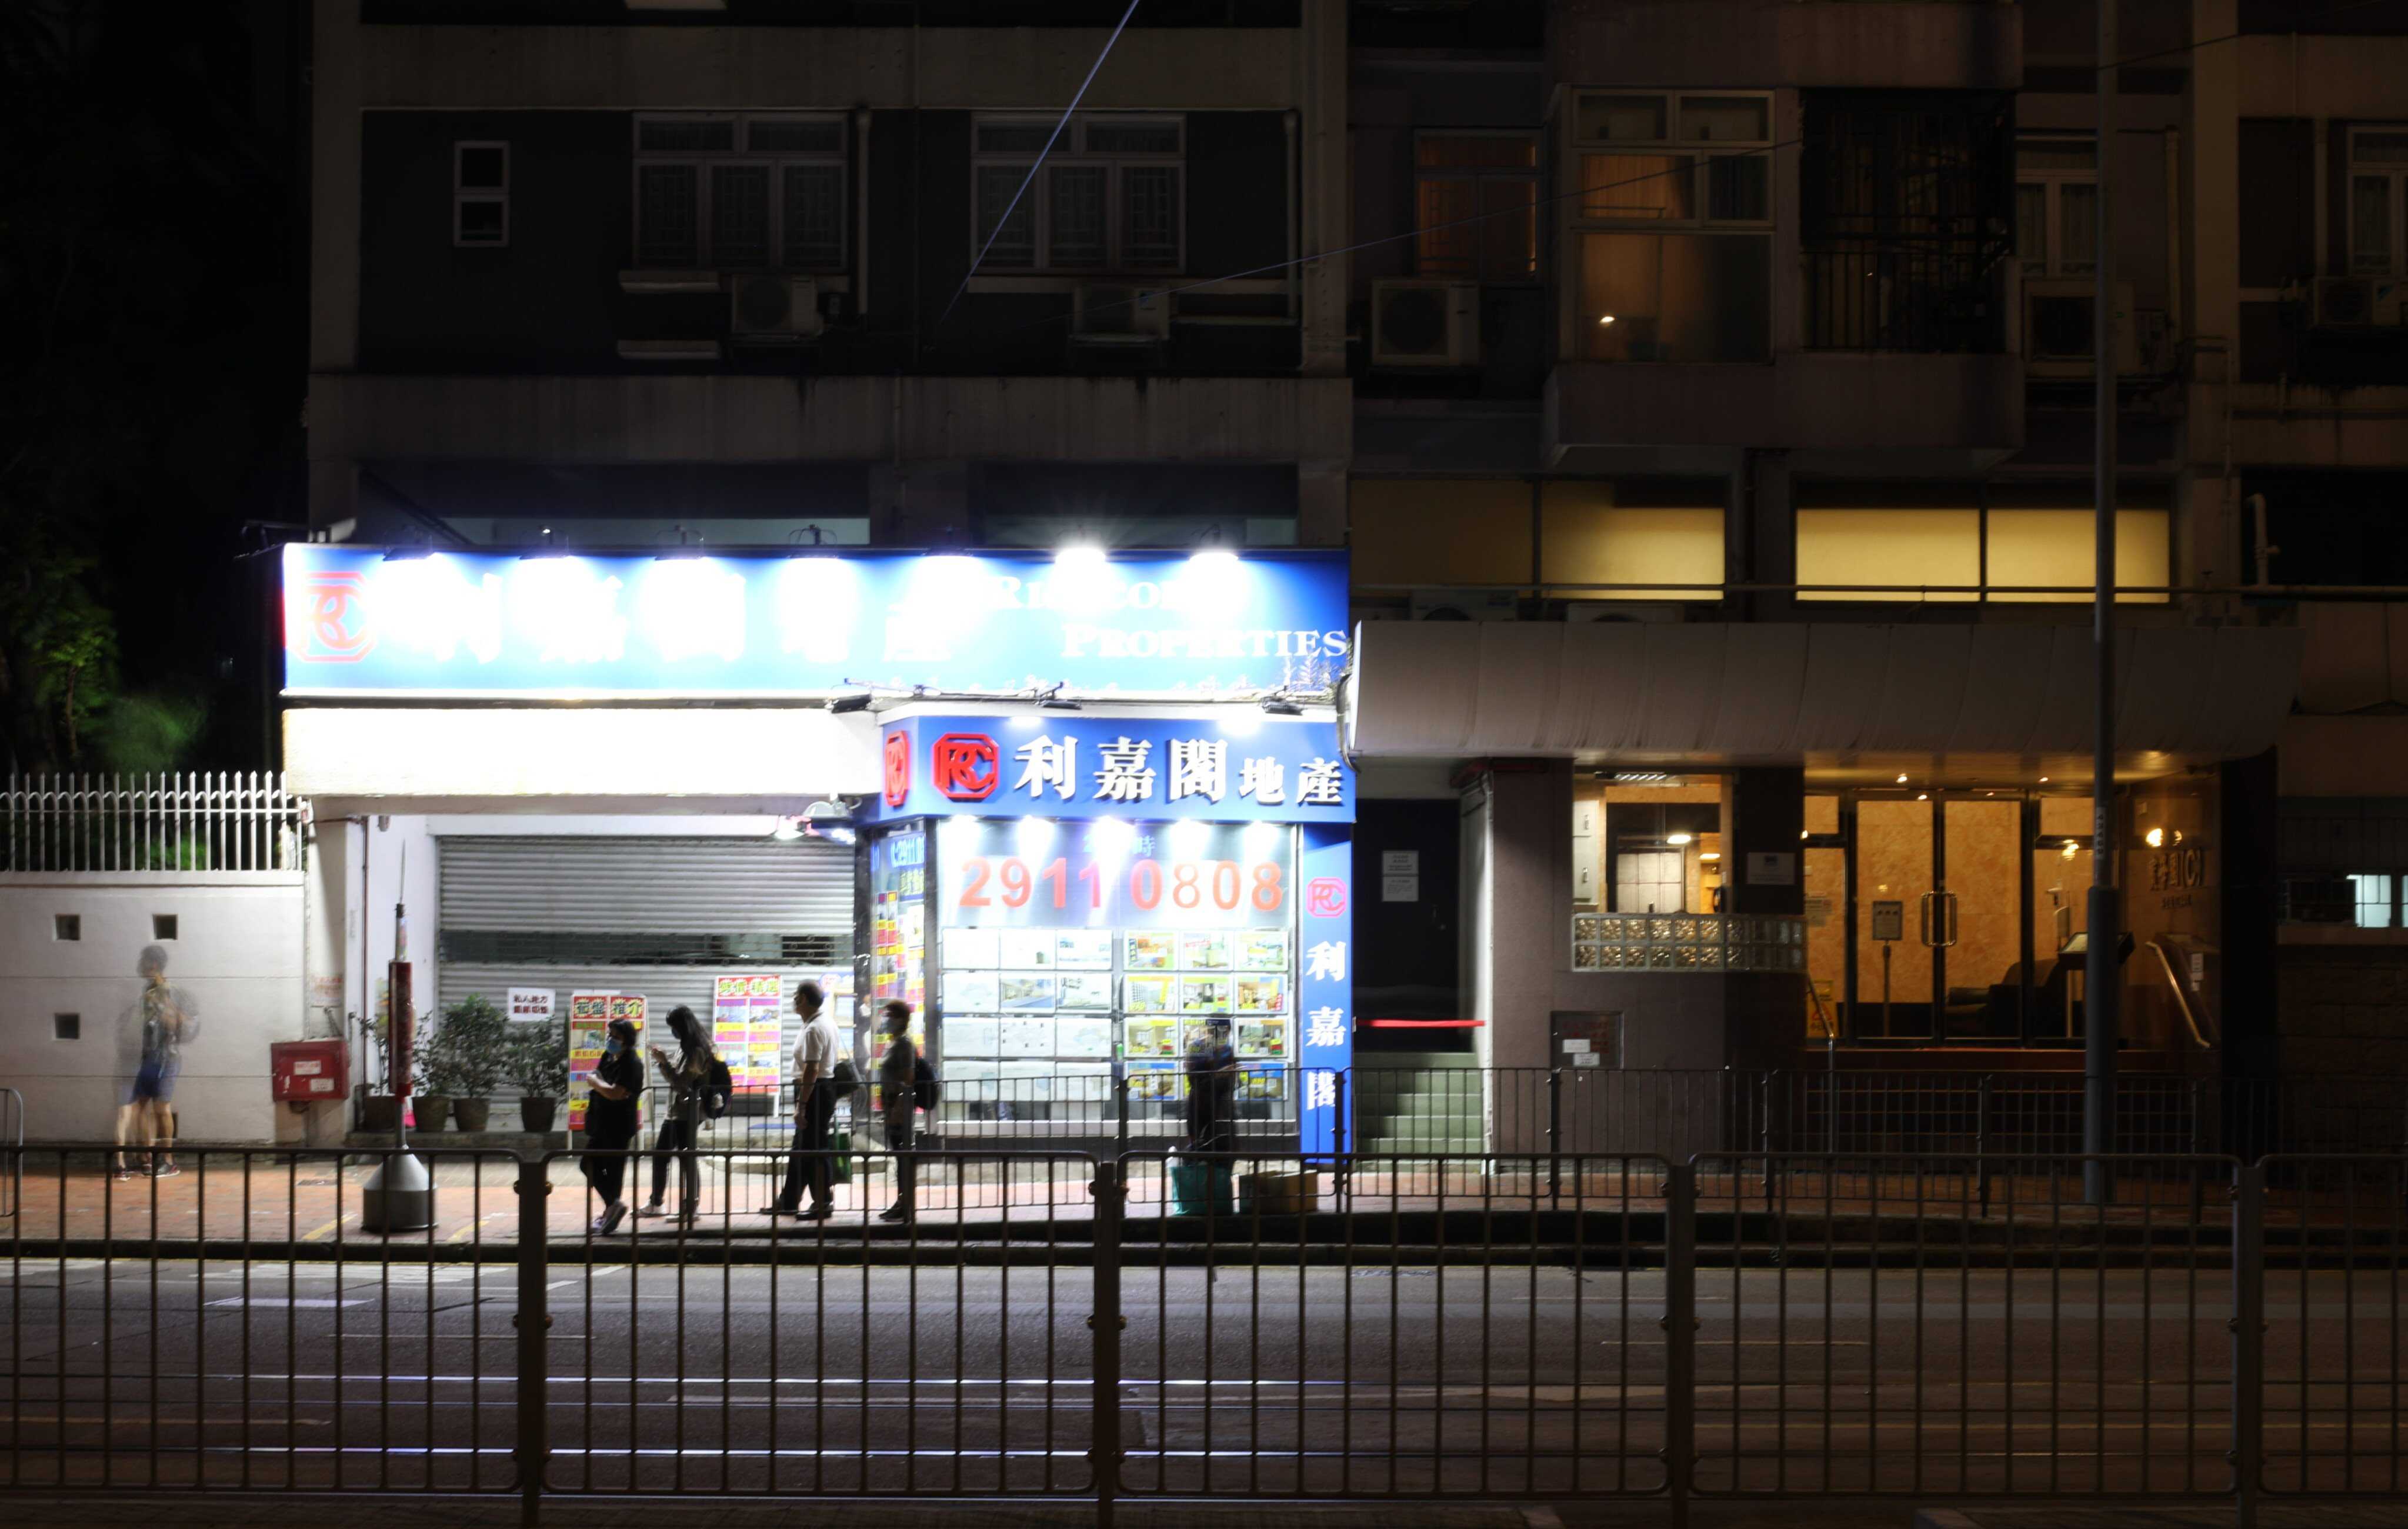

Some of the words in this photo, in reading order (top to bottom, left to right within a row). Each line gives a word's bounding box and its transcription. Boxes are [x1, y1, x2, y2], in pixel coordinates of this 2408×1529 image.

[1014, 735, 1343, 805] 利嘉閣地產
